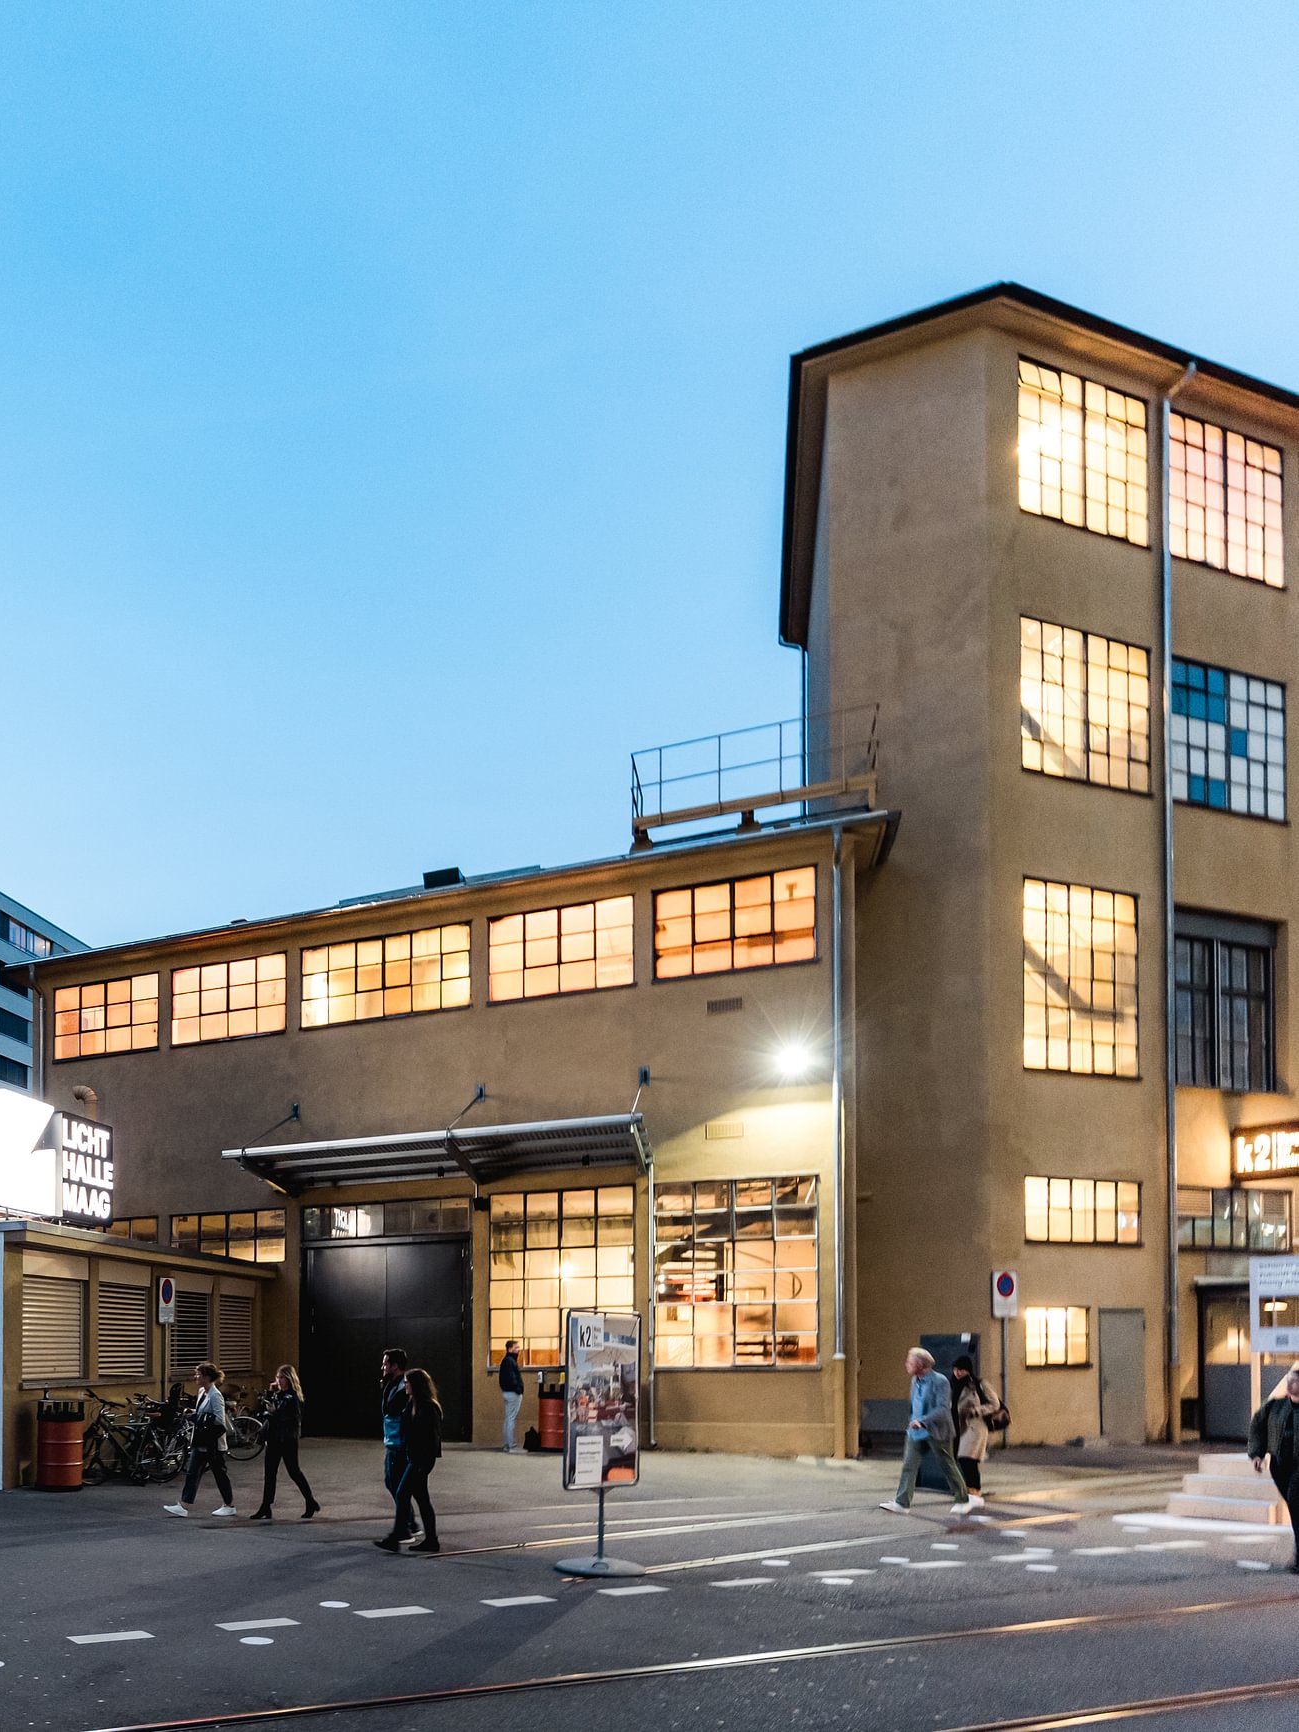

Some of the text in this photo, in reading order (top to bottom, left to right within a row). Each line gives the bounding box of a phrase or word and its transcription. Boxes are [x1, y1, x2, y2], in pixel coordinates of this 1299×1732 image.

[62, 1118, 110, 1158] LICHT
[1236, 1133, 1271, 1173] k2
[62, 1150, 113, 1190] HALLE
[62, 1182, 111, 1219] MAAG
[579, 1325, 591, 1347] k2
